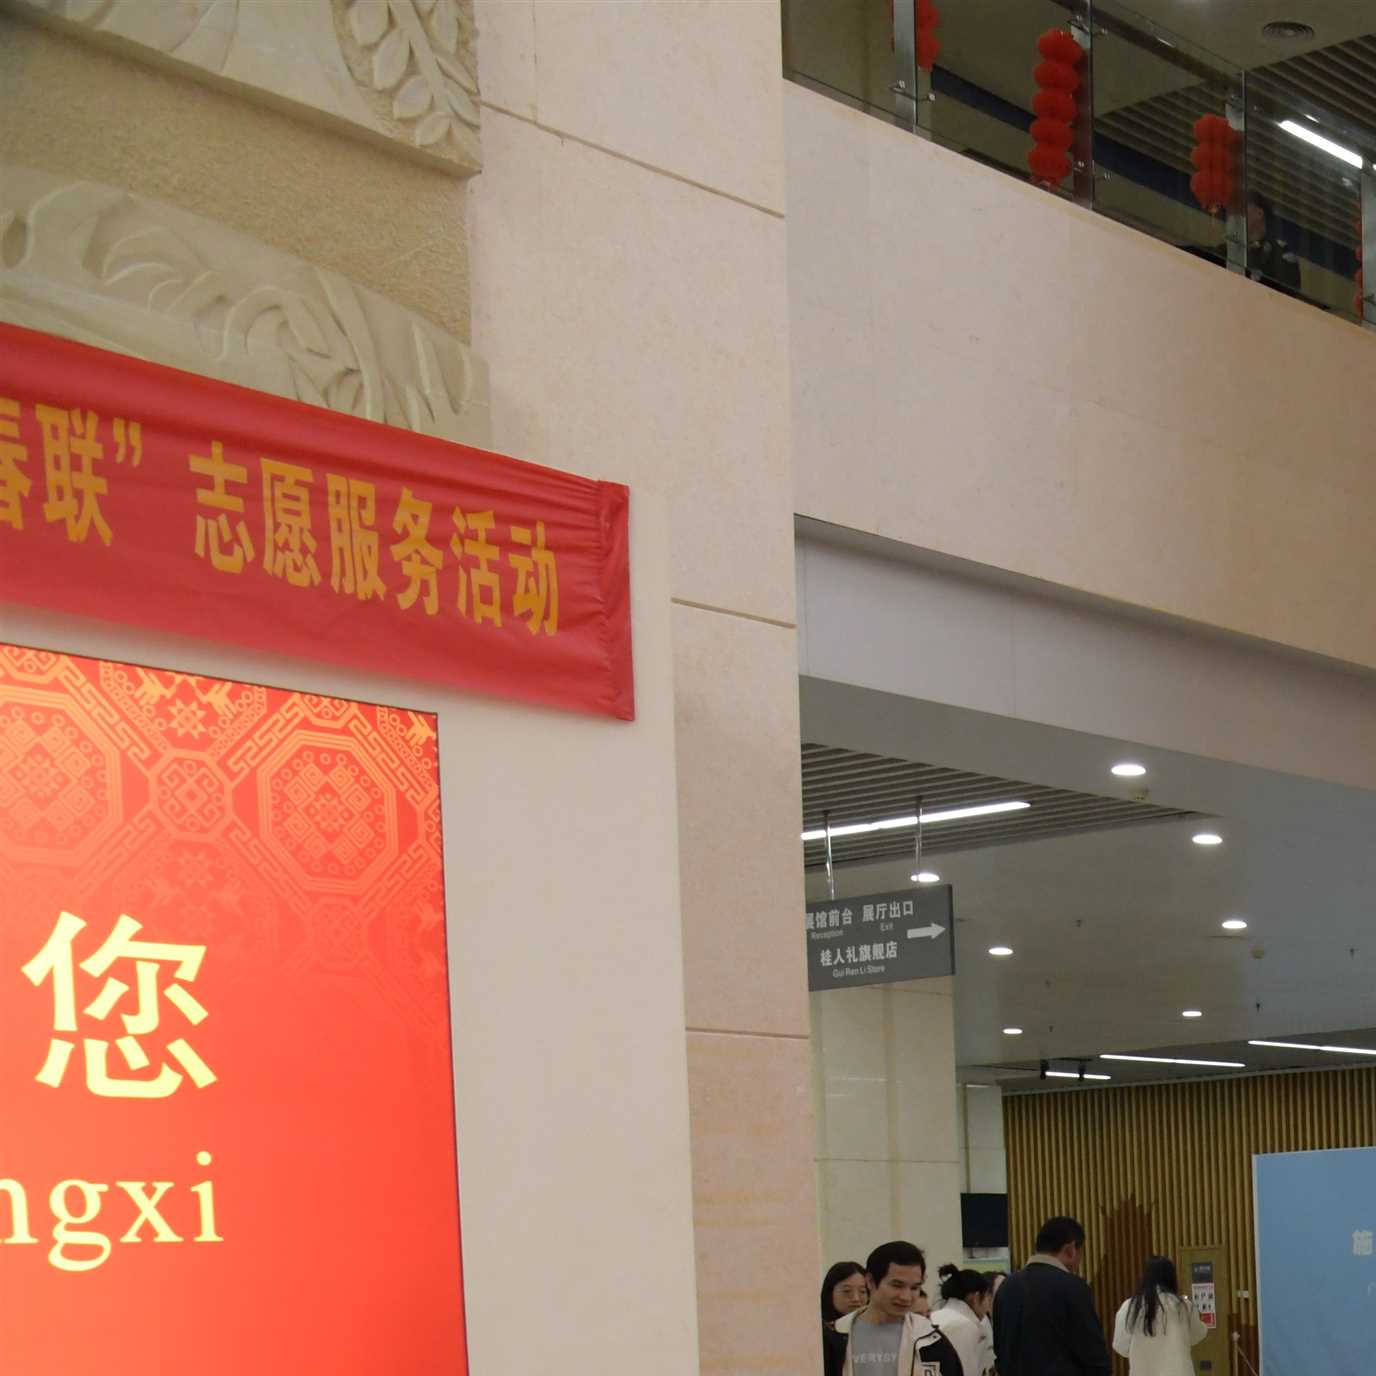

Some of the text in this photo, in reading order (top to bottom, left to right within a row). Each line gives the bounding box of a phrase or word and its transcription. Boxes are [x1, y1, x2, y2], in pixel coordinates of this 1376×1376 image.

[863, 901, 913, 922] 展厅出口
[820, 941, 898, 966] 桂人礼旗舰店
[833, 968, 845, 978] Gui
[845, 967, 859, 976] Ren
[867, 964, 886, 975] Store
[20, 910, 218, 1099] 您
